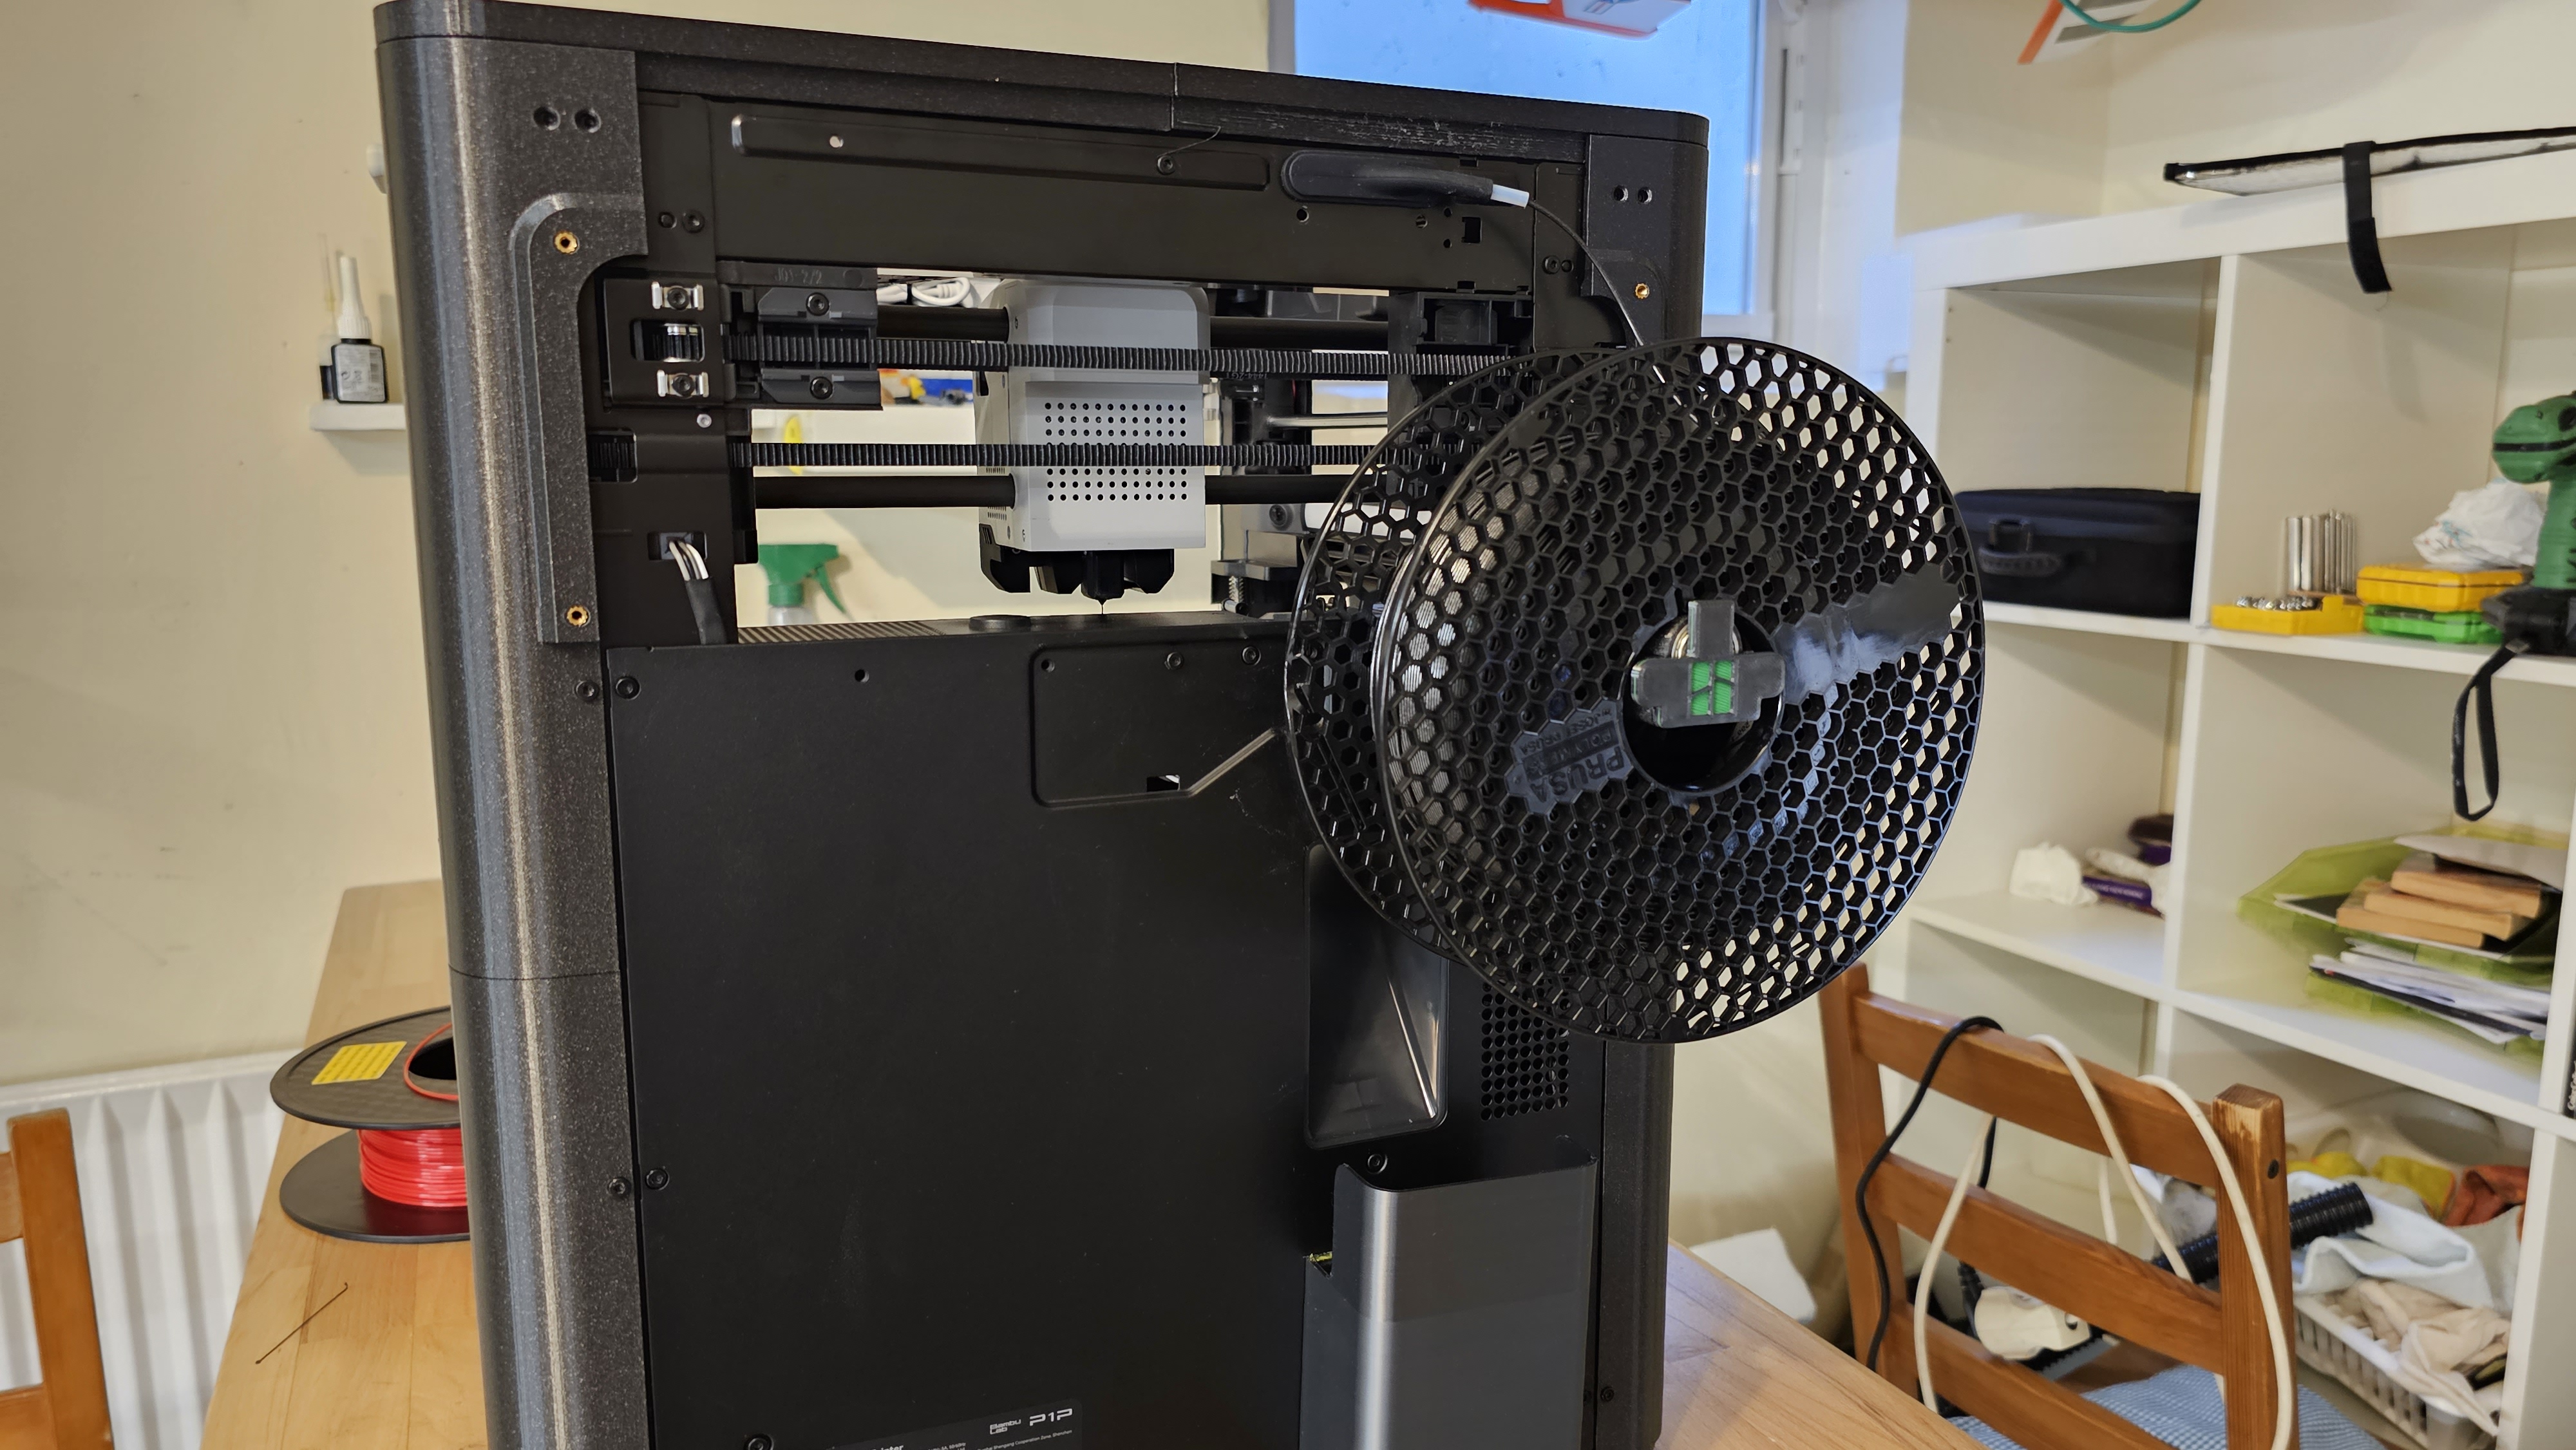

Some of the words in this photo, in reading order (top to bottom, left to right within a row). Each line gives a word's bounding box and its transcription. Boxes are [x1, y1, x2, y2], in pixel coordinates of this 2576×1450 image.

[1530, 746, 1625, 804] PRUSA
[989, 1418, 1022, 1429] Bambu
[1029, 1408, 1074, 1427] P1P
[989, 1426, 1008, 1435] Lab
